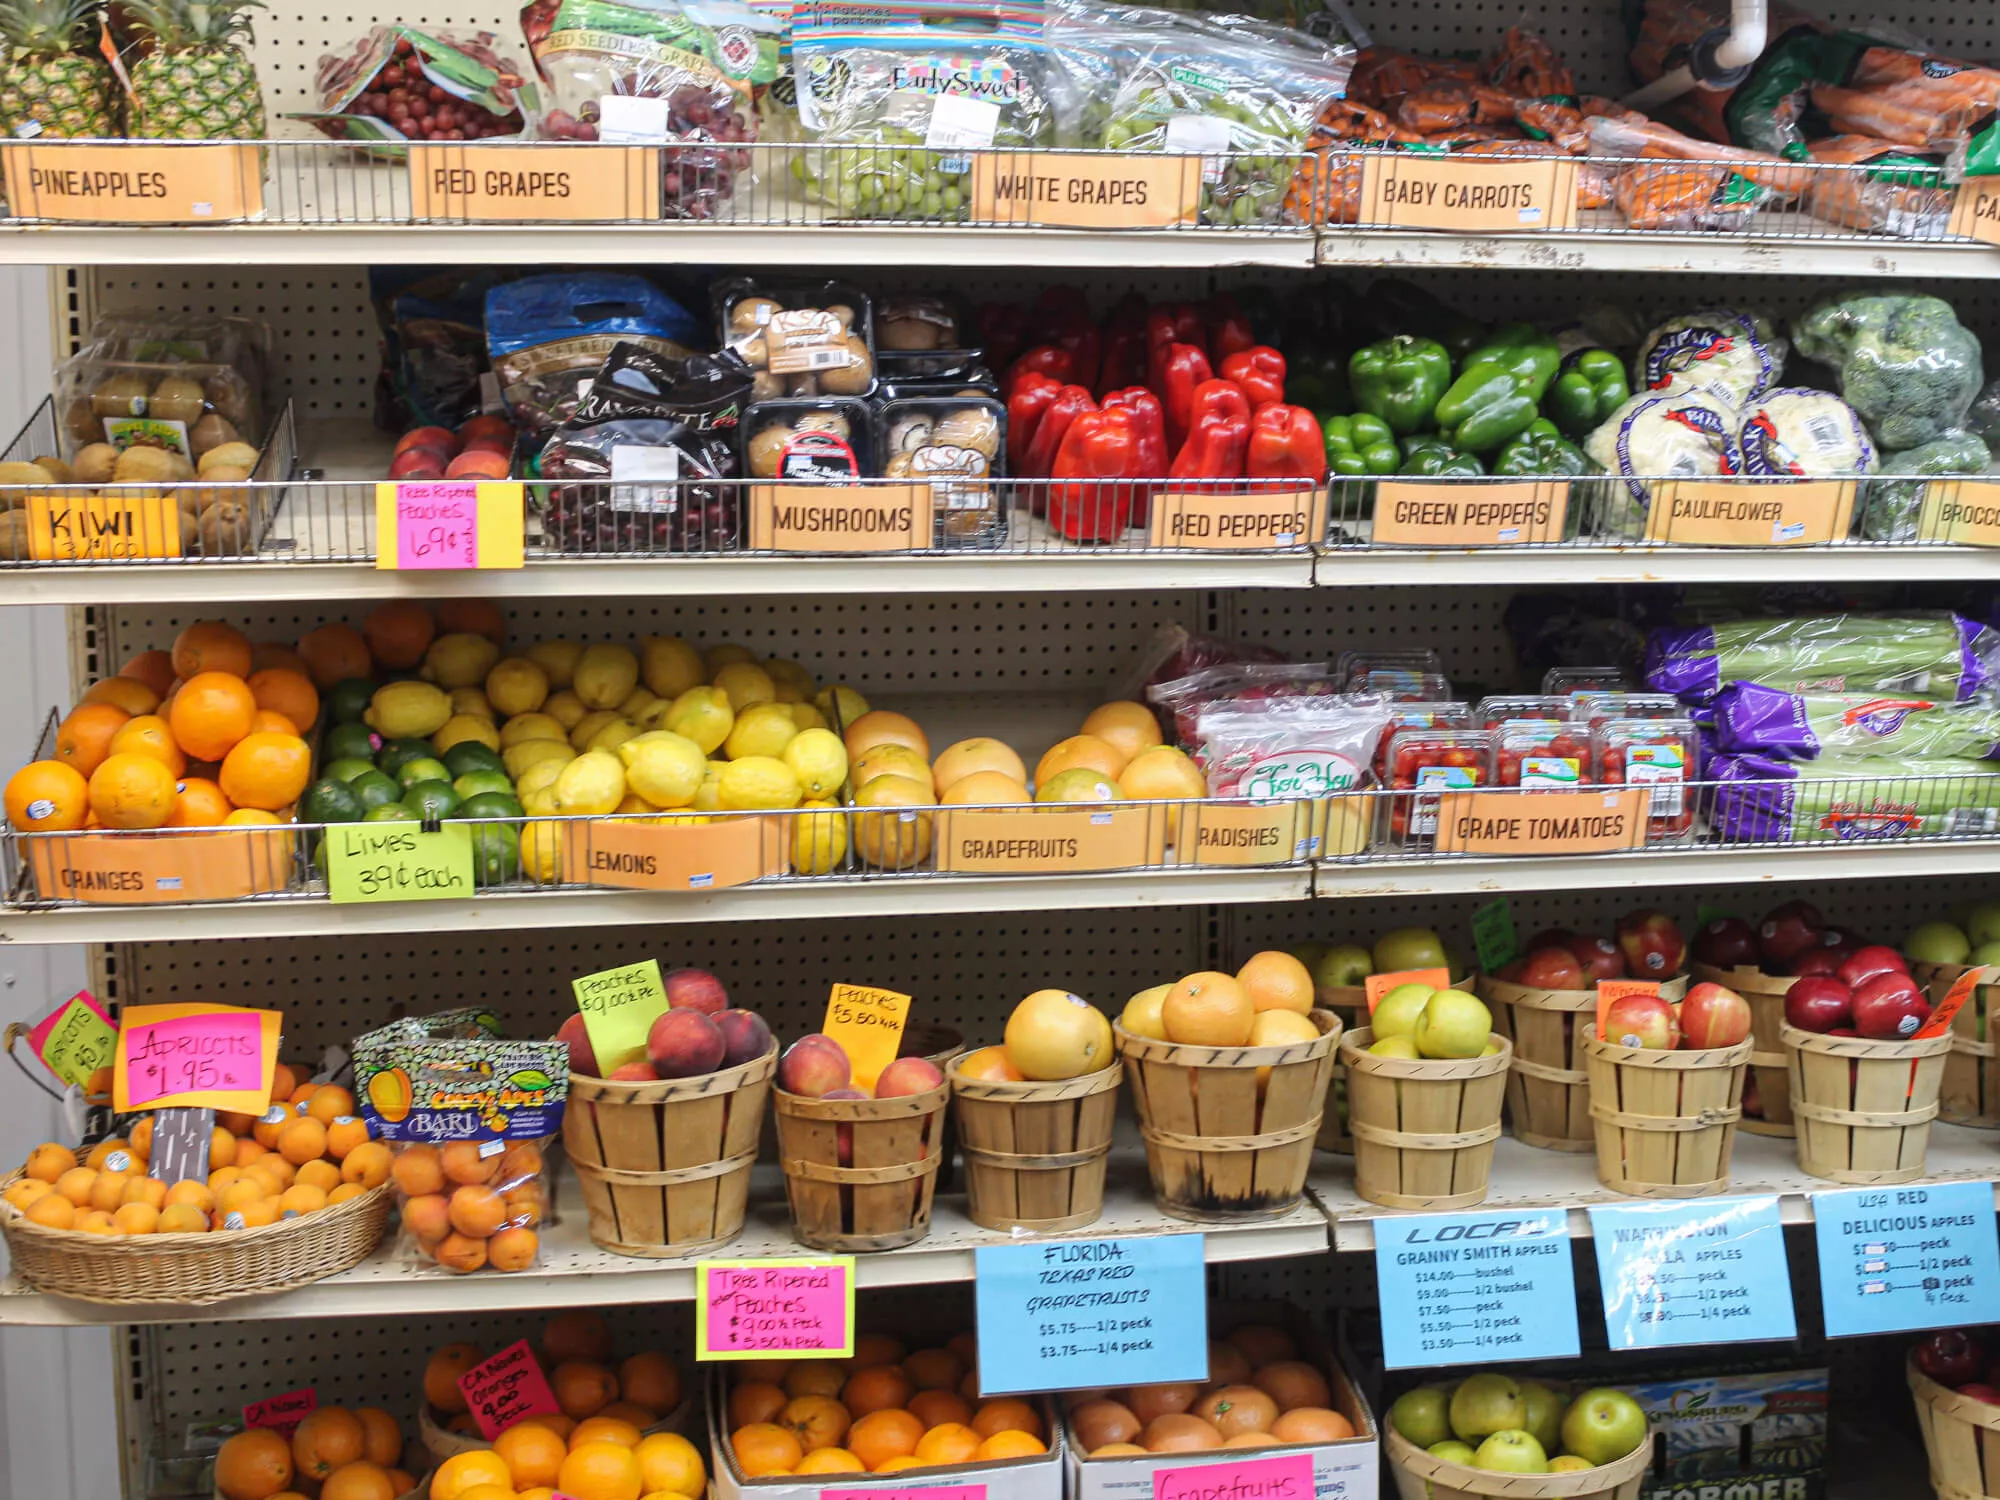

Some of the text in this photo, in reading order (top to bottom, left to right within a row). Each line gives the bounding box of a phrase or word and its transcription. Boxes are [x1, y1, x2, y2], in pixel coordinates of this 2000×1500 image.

[31, 167, 167, 199] PINEAPPLES
[434, 168, 571, 198] RED GRAPES
[995, 174, 1149, 205] WHITE GRAPES
[1383, 178, 1533, 210] BABY CARROTS
[1974, 193, 2000, 222] CA
[773, 506, 912, 533] MUSHROOMS
[1394, 501, 1549, 526] GREEN PEPPERS
[1671, 499, 1784, 521] CAULIFLOWER
[50, 508, 133, 538] KIWI
[1172, 512, 1307, 538] RED PEPPERS
[1199, 826, 1280, 848] RADISHES
[1457, 814, 1625, 841] GRAPE TOMATOES
[962, 836, 1077, 860] GRAPEFRUITS
[587, 850, 657, 875] LEMONS
[62, 867, 144, 891] ORANGES
[414, 864, 464, 890] each
[416, 1112, 475, 1134] BARI
[1896, 1190, 1928, 1206] RED
[1843, 1214, 1976, 1235] DELICIOUS APPLES
[1043, 1241, 1125, 1265] FLORIDA
[1397, 1243, 1559, 1267] GRANNY SMITH APPLES
[1919, 1237, 1951, 1252] peck
[1695, 1249, 1743, 1263] APPLES
[1919, 1255, 1973, 1271] 1/2 peck
[1495, 1280, 1534, 1294] bushel
[1697, 1269, 1727, 1286] peck
[1944, 1275, 1974, 1290] peck
[1719, 1287, 1749, 1302] peck
[1475, 1300, 1505, 1315] peck
[1721, 1304, 1752, 1319] peck
[1120, 1316, 1152, 1332] peck
[1494, 1315, 1522, 1329] peck
[1121, 1338, 1154, 1354] peck
[1495, 1332, 1523, 1346] peck
[1160, 1473, 1297, 1500] Grapefruits
